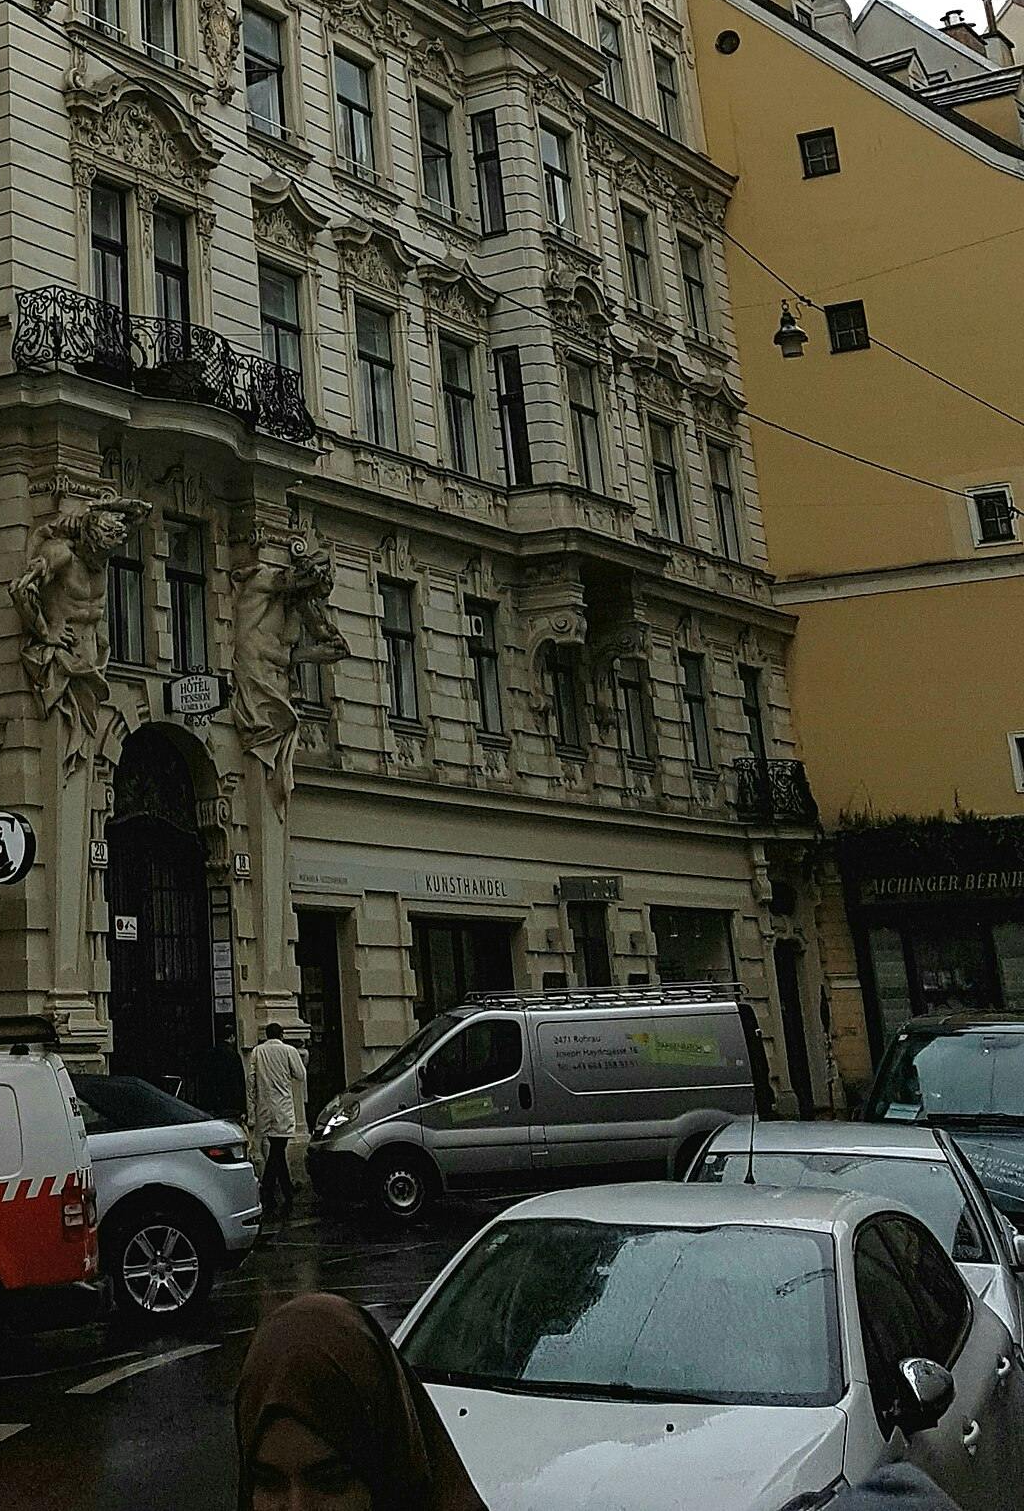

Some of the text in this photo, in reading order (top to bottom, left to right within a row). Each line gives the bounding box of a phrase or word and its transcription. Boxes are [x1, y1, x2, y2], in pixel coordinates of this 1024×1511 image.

[180, 680, 210, 694] HOTEL
[180, 692, 211, 703] PENSION
[94, 842, 105, 857] 20
[425, 874, 508, 897] KUNSTHANDEL
